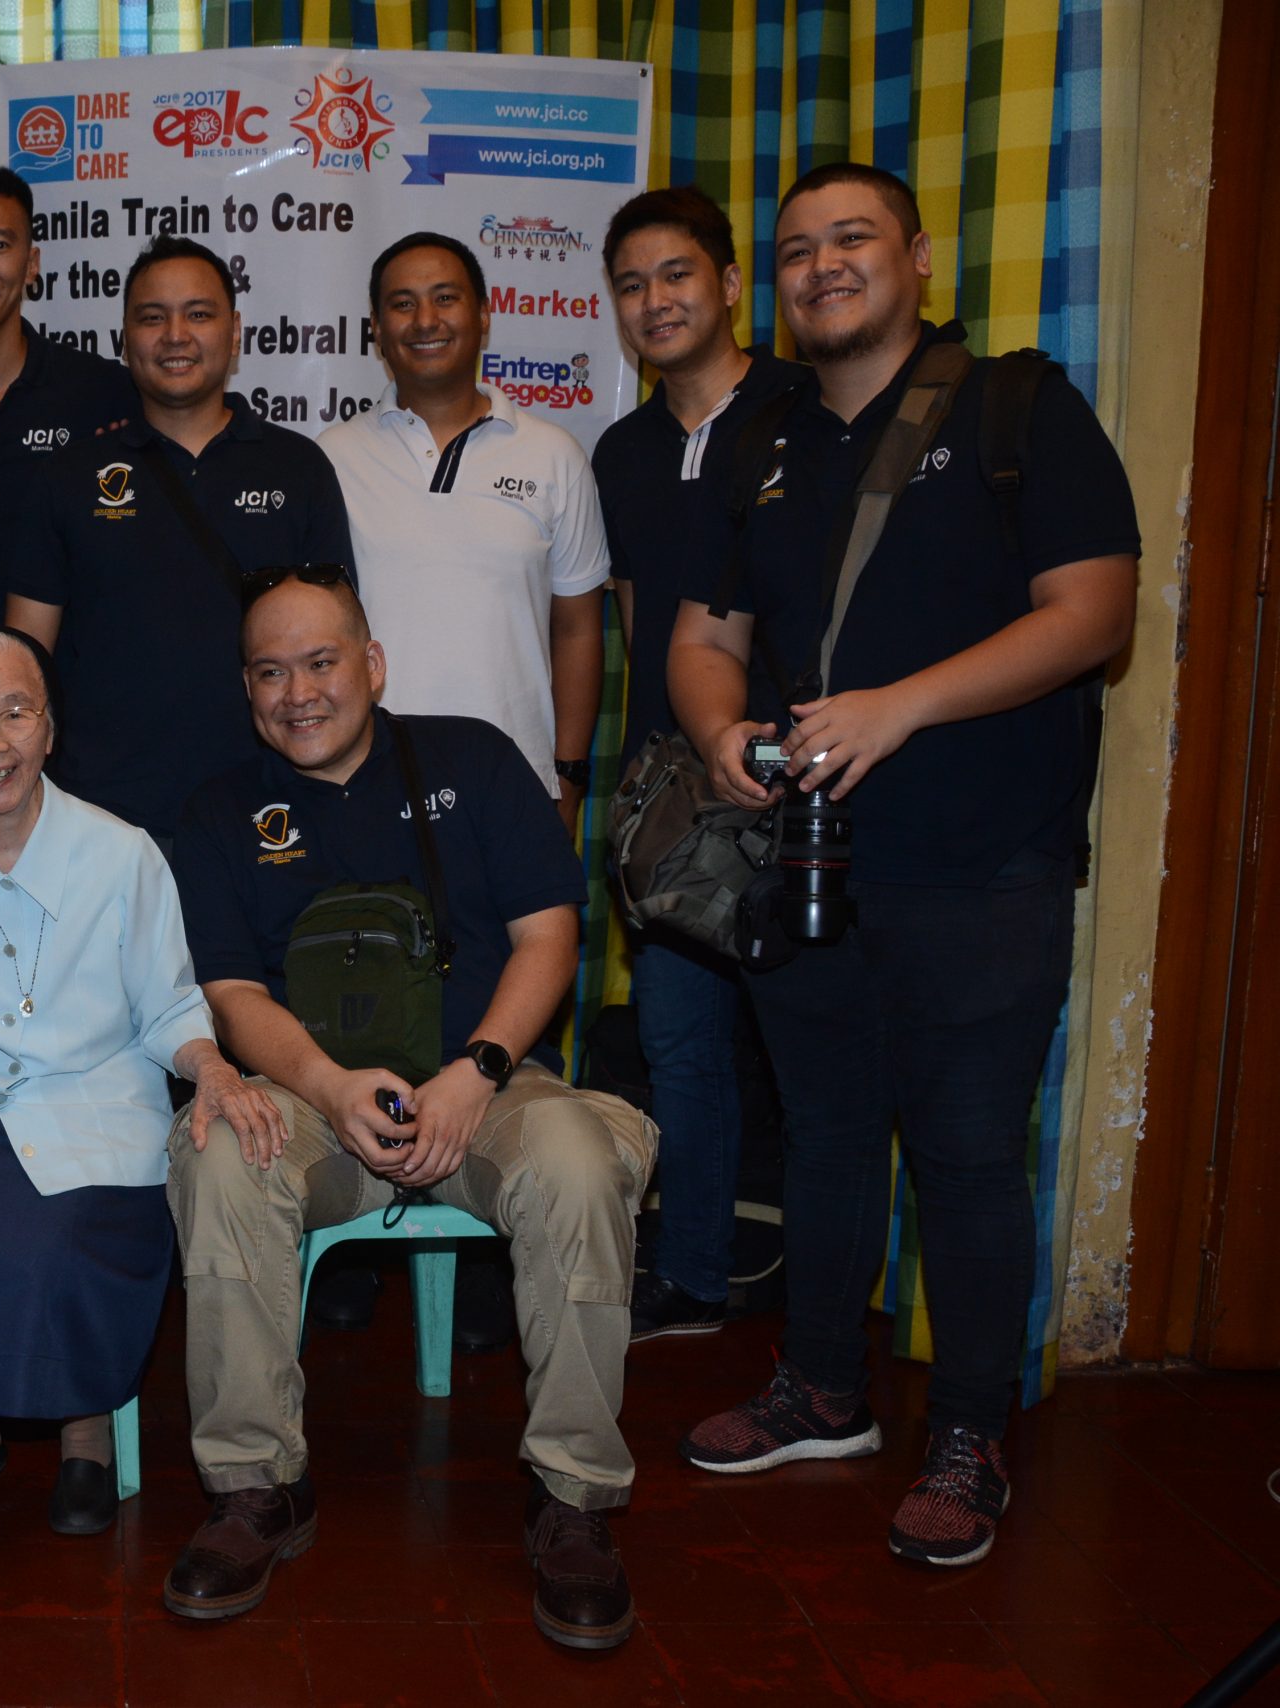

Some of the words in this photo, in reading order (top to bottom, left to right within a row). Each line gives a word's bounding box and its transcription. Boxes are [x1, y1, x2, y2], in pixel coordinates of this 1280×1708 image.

[77, 92, 130, 120] DARE
[153, 94, 172, 105] JCI
[183, 90, 226, 107] 2017
[495, 104, 589, 123] www.jci.cc
[77, 123, 103, 151] TO
[329, 135, 360, 148] UNITY
[194, 147, 269, 158] PRESIDENTS
[320, 153, 350, 168] JCI
[478, 148, 606, 171] www.jci.org.ph
[77, 152, 129, 181] CARE
[32, 200, 109, 242] anila
[121, 195, 210, 237] Train
[223, 194, 259, 233] to
[271, 192, 354, 232] Care
[480, 226, 583, 251] CHINATOWN
[26, 270, 59, 302] or
[68, 260, 120, 299] the
[491, 287, 600, 320] Market
[243, 316, 347, 354] rebral
[482, 353, 571, 385] Entrep
[251, 387, 308, 422] San
[320, 387, 381, 422] Jos
[21, 428, 54, 446] JCI
[493, 477, 523, 492] JCI
[501, 490, 524, 501] Manila
[234, 490, 269, 507] JCI
[244, 506, 269, 514] Manila
